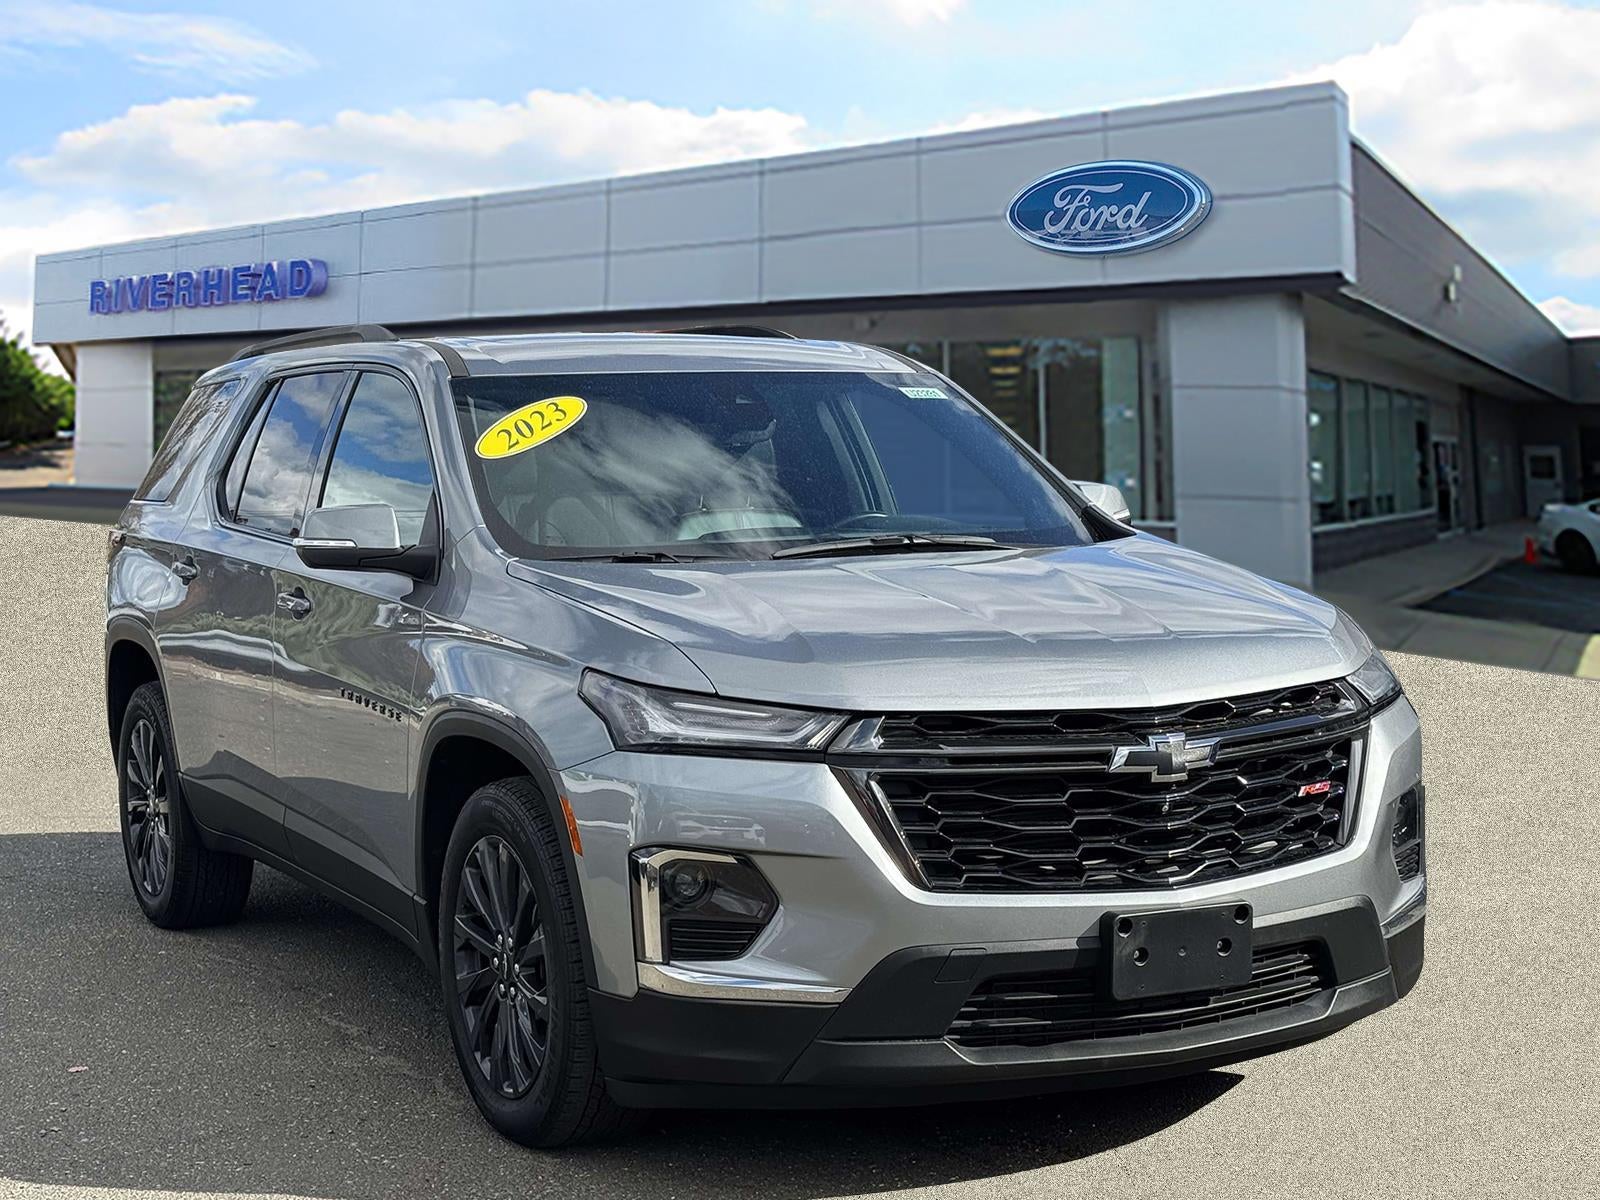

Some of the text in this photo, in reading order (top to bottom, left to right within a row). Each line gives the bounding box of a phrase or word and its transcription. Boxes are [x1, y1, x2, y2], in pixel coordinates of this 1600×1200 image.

[1043, 182, 1152, 234] Ford
[89, 258, 327, 315] RIVERHEAD
[497, 402, 567, 450] 2023
[339, 686, 402, 722] TRAVERSE
